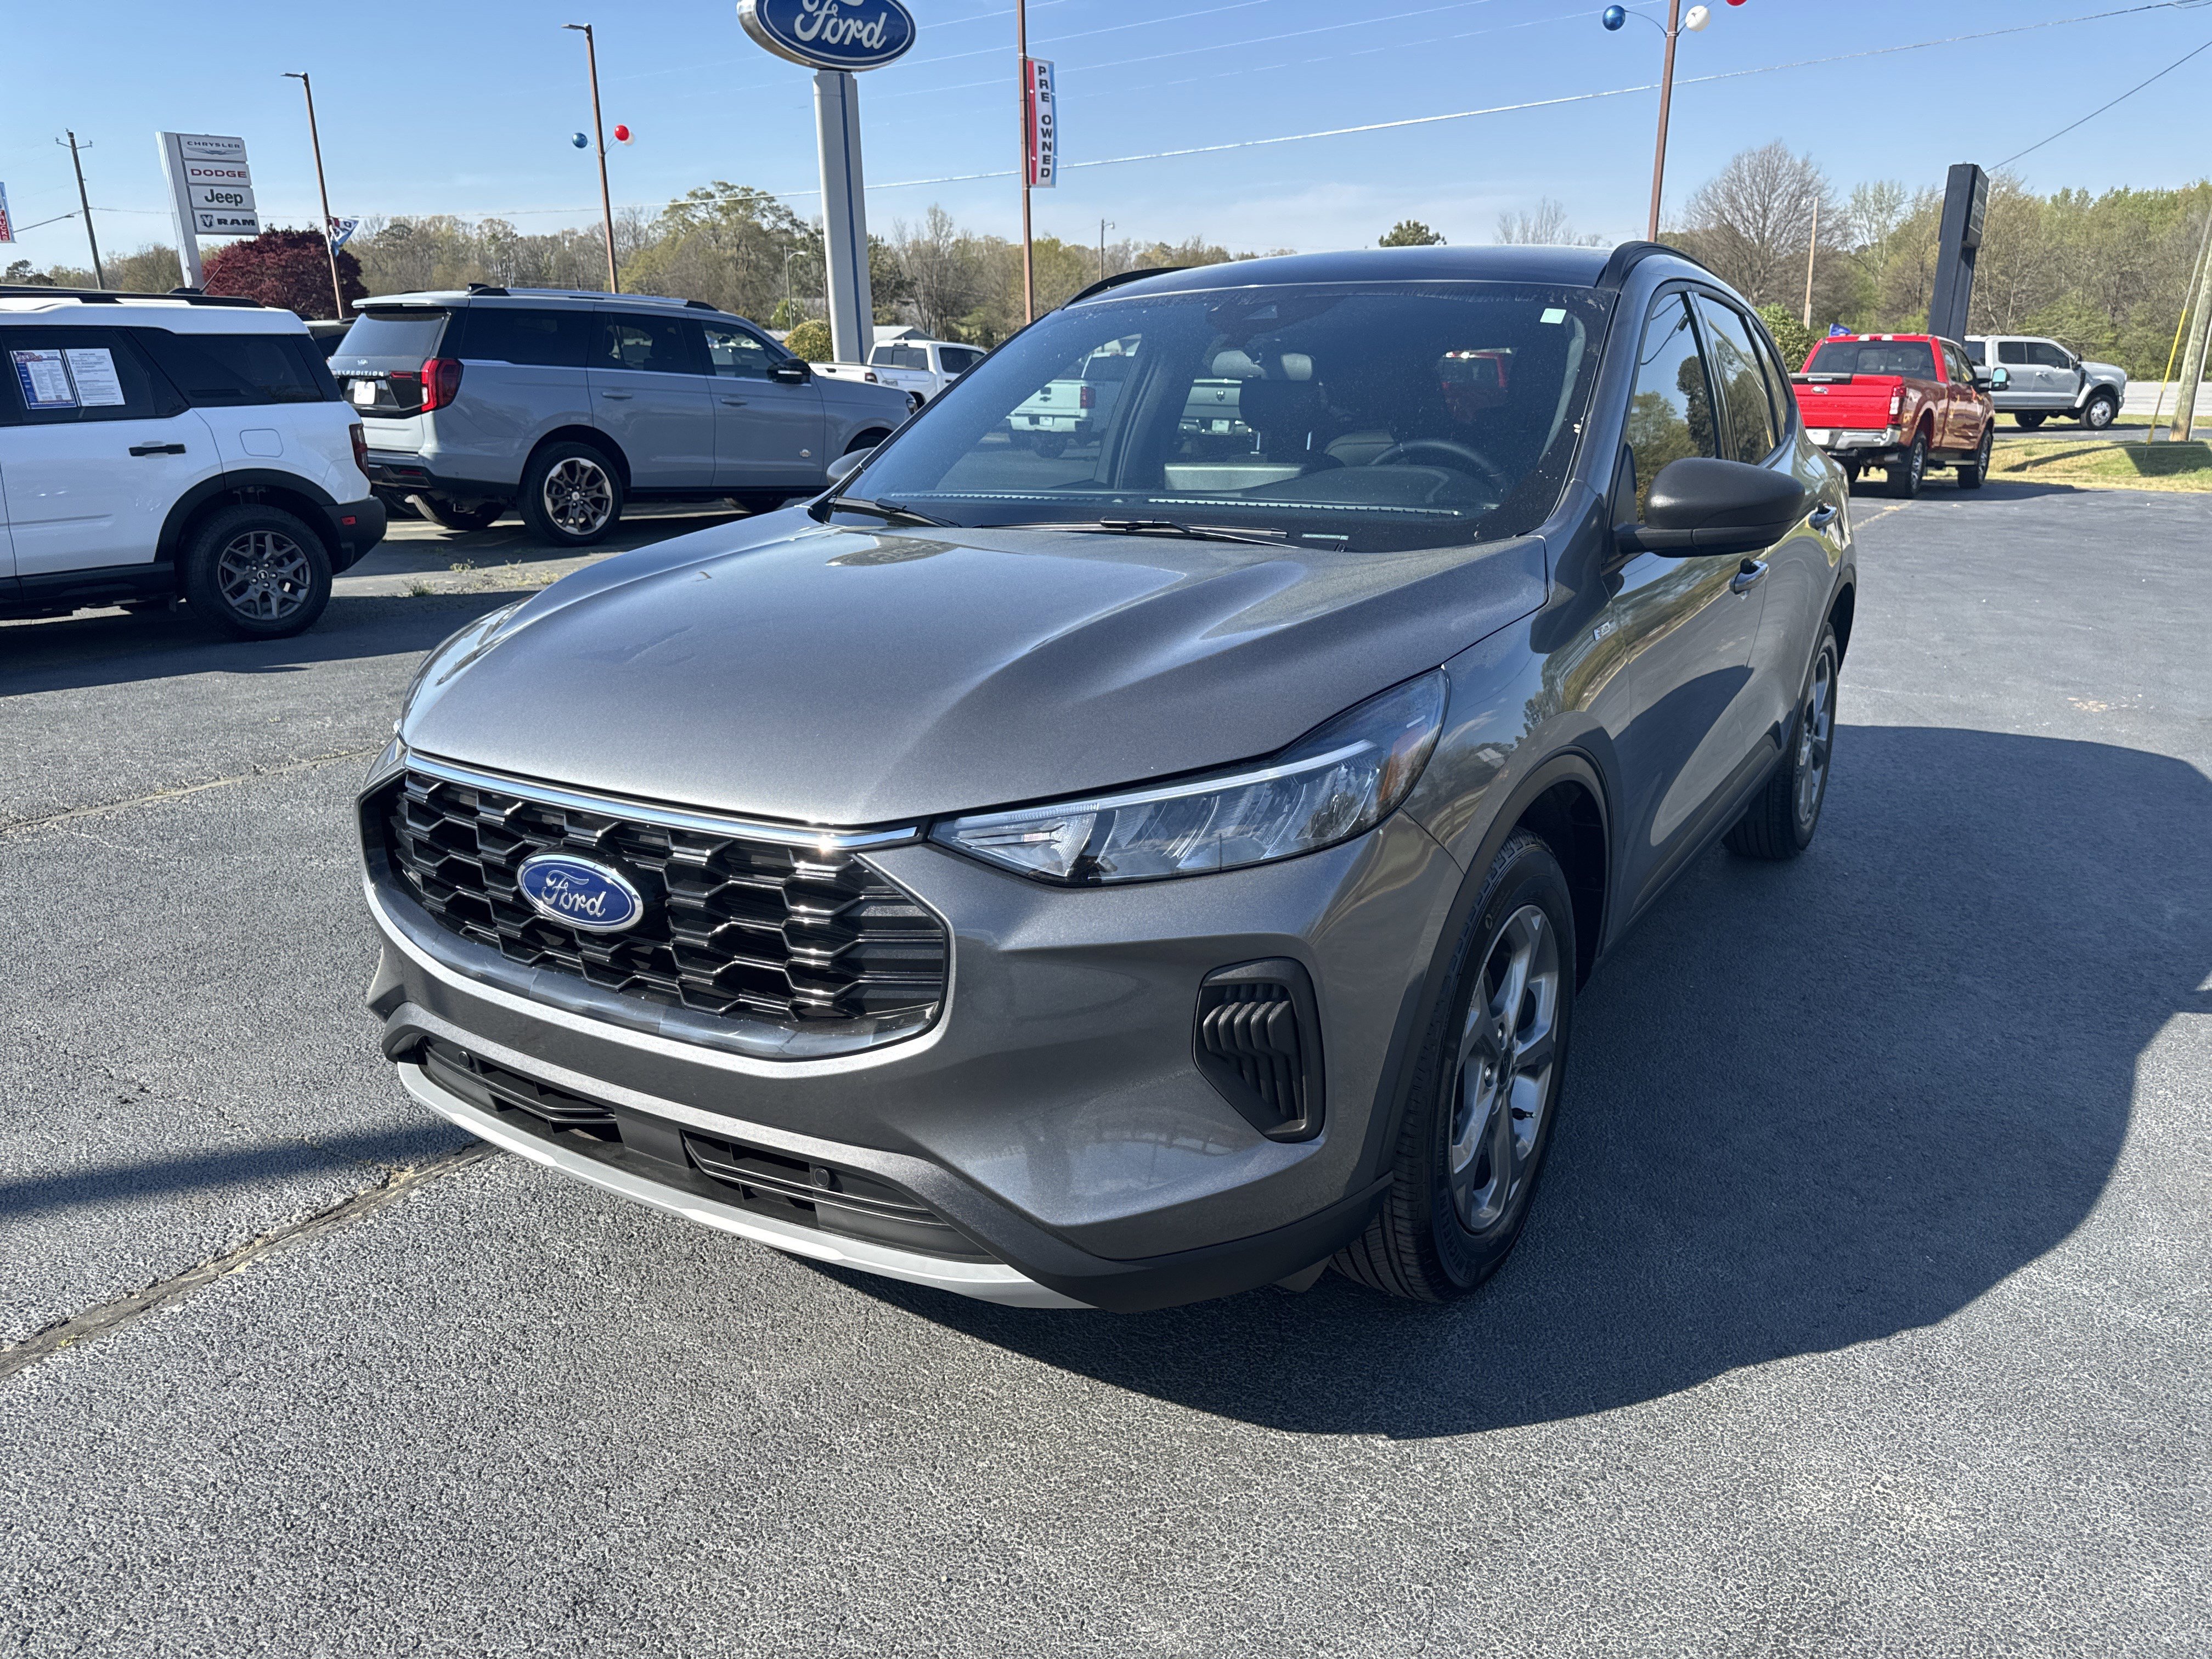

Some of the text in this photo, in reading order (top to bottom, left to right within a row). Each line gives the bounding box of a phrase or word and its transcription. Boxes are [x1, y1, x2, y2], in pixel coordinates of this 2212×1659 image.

[794, 0, 887, 49] Ford
[1037, 65, 1053, 178] PRE OWNED
[190, 168, 247, 178] DODGE
[204, 189, 243, 206] Jeep
[217, 218, 256, 226] RAM
[541, 870, 607, 918] Ford
[1438, 1192, 1468, 1272] MICHELIN
